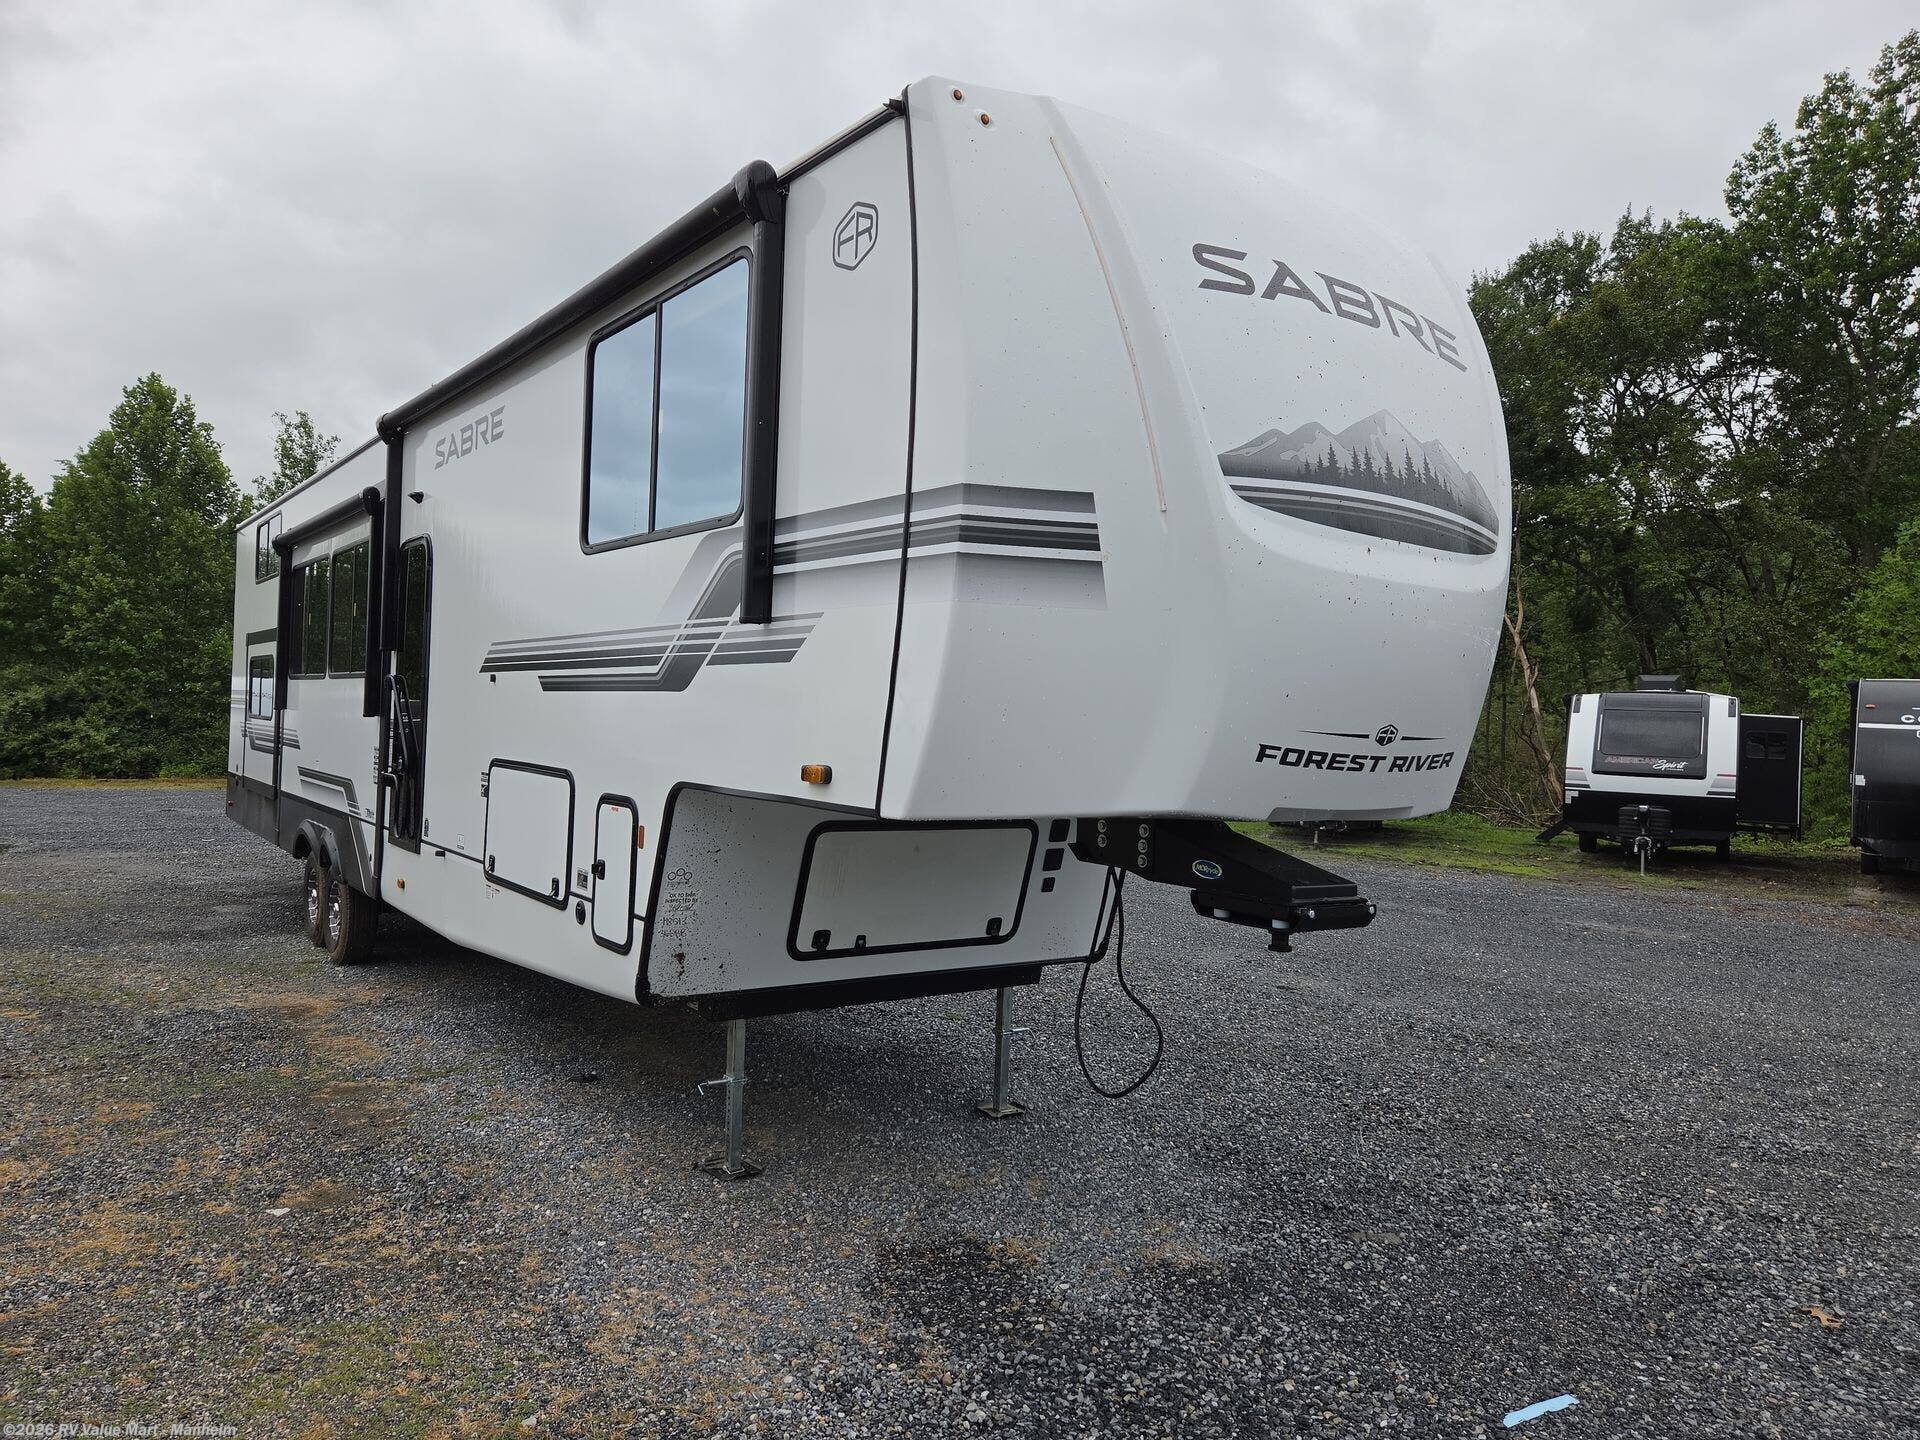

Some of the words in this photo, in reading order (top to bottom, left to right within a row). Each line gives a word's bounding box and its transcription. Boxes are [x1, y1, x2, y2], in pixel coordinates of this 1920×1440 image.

[1192, 243, 1468, 372] SABRE
[434, 405, 506, 470] SABRE
[1901, 714, 1920, 724] C
[1255, 743, 1387, 773] FOREST
[1388, 751, 1455, 773] RIVER
[1604, 755, 1660, 765] AMERICAN
[1652, 759, 1688, 771] Spirit
